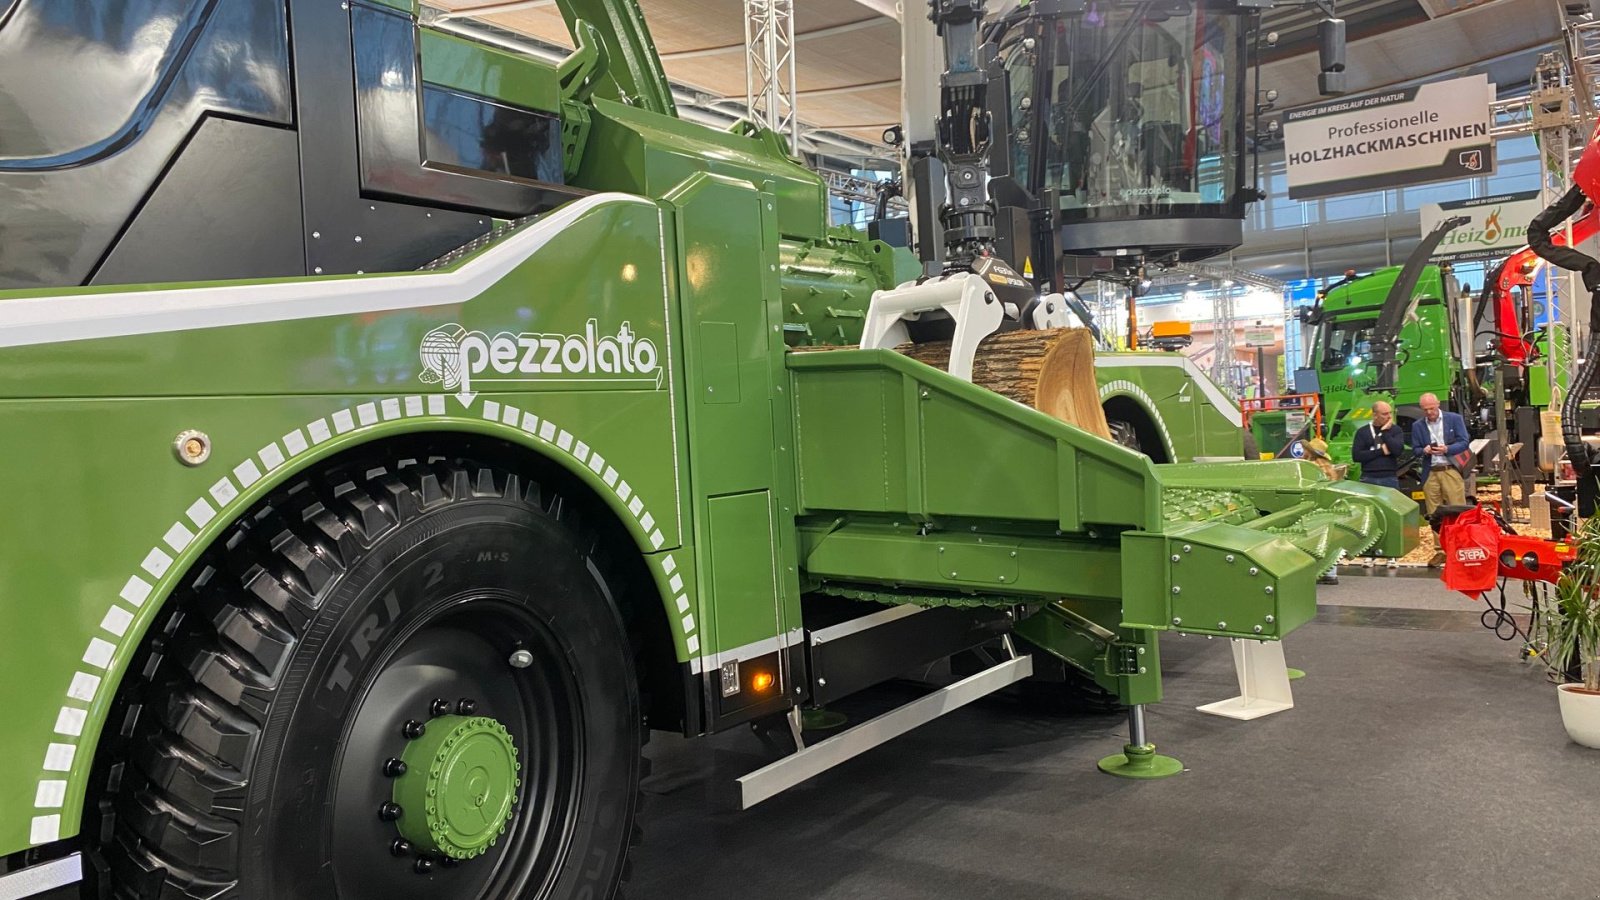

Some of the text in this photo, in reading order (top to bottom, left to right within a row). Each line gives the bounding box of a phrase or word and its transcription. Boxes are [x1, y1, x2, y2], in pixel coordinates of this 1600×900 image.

[1289, 93, 1405, 120] ENERGIE IM KREISLAUF DER NATUR
[1329, 110, 1439, 139] Professionelle
[1289, 123, 1487, 166] HOLZHACKMASCHINEN
[1126, 184, 1171, 201] pezzolato
[458, 319, 657, 396] pezzolato
[477, 551, 510, 562] M+S
[1458, 548, 1487, 561] STEPA
[326, 562, 445, 692] TRI 2
